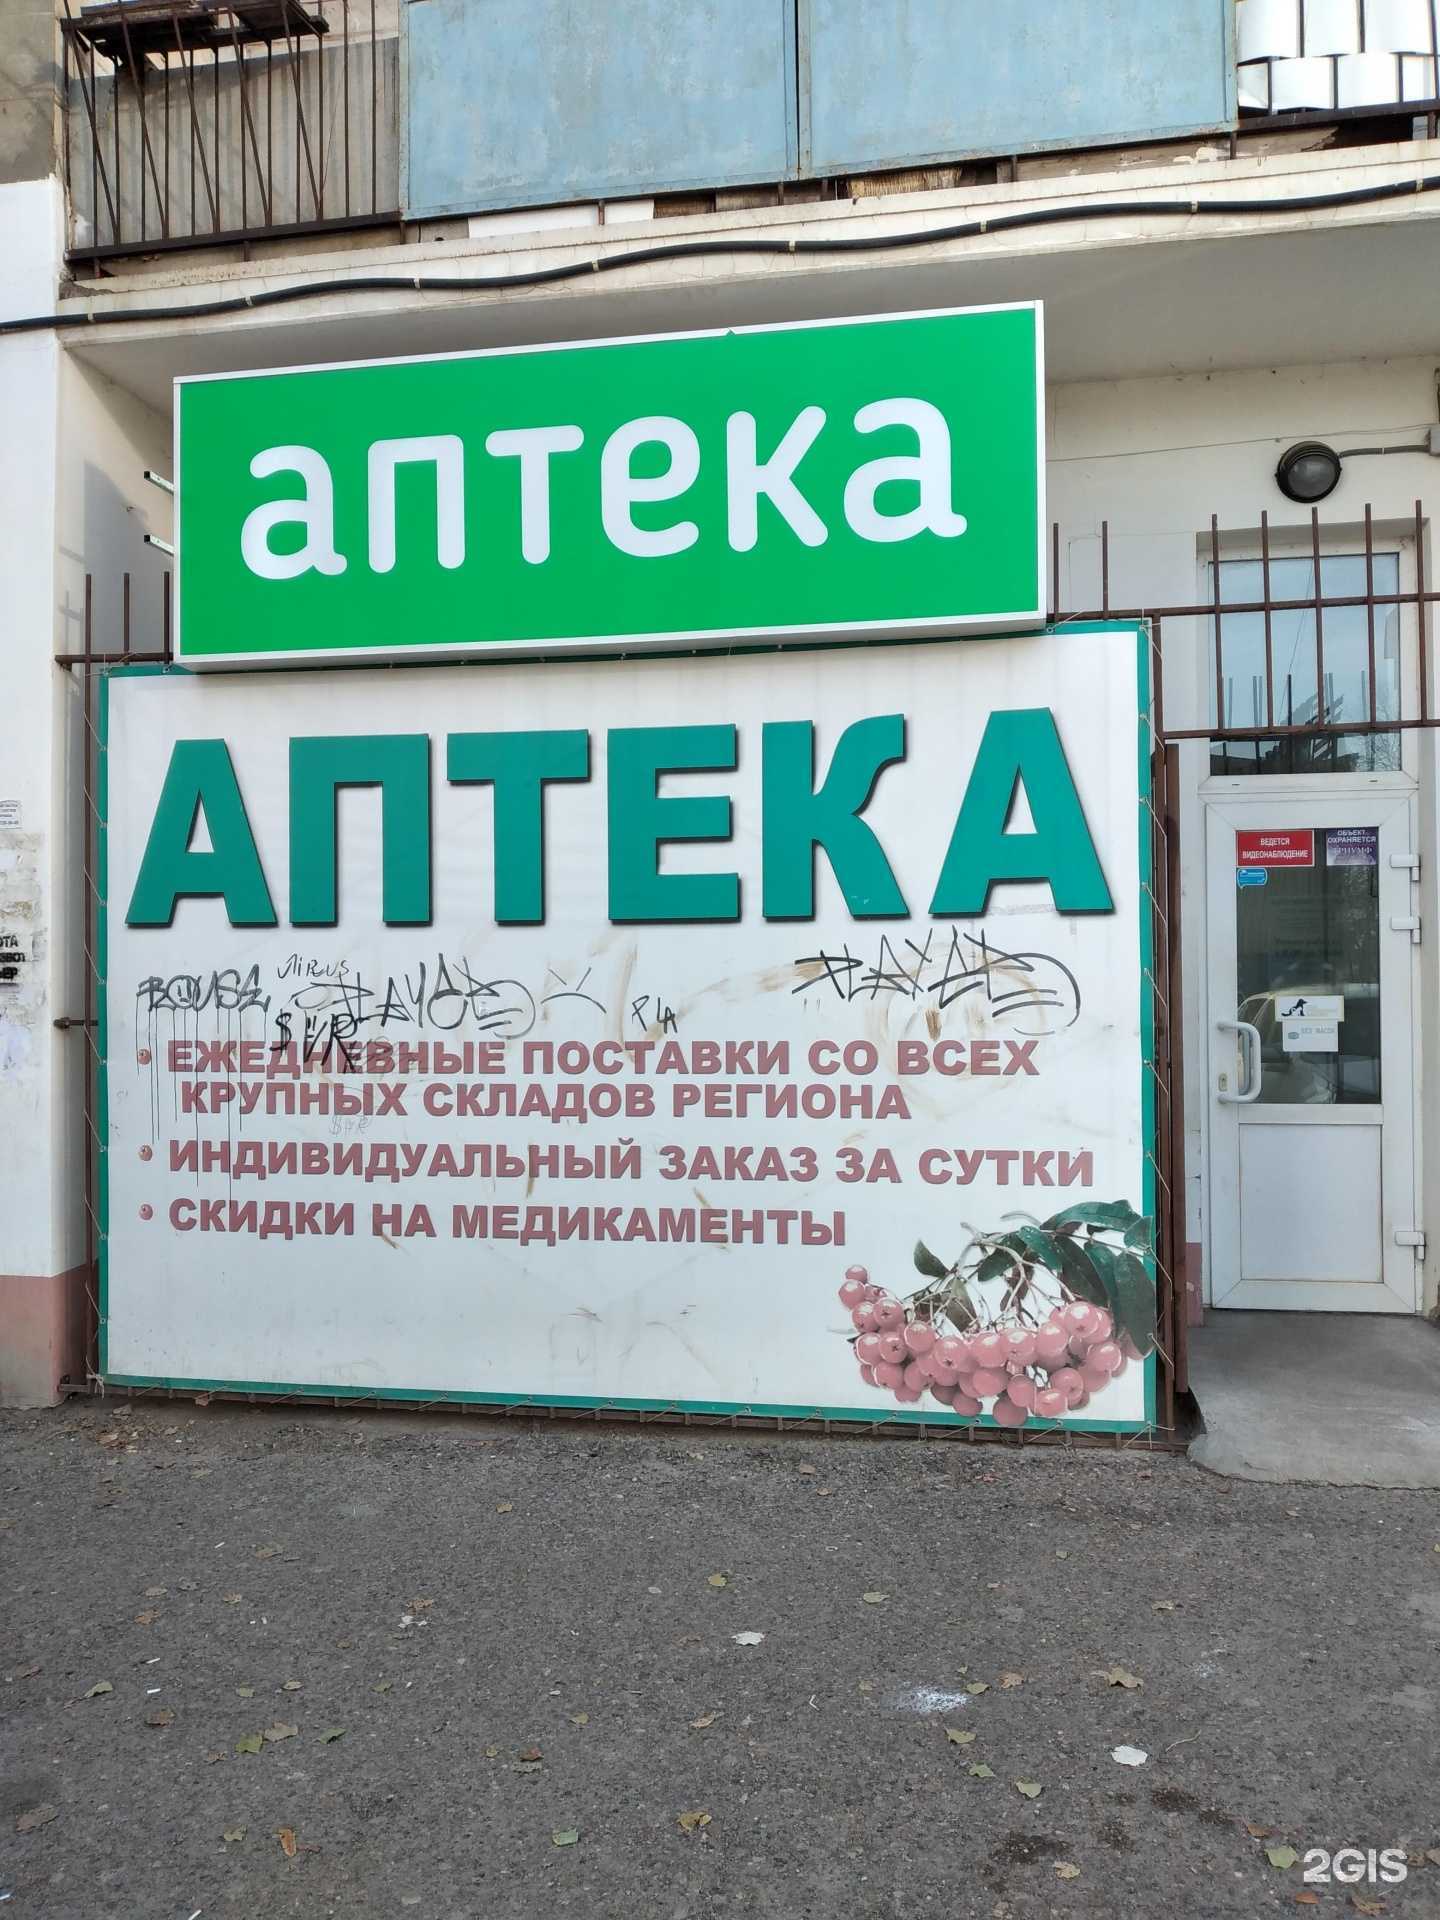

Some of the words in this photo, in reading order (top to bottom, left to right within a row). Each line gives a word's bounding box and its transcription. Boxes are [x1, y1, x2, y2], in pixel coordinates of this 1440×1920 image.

[241, 397, 967, 580] аптека
[125, 707, 1117, 927] АПТЕКА
[1242, 849, 1309, 861] ВИДЕОНАБЛЮДЕНИЕ
[1260, 837, 1290, 847] ВЕДЕТСЯ
[1327, 836, 1377, 844] ОХРАНЯЕТСЯ
[168, 1039, 505, 1080] ЕЖЕДНЕВНЫЕ
[523, 1039, 790, 1075] ПОСТАВКИ
[807, 1039, 879, 1076] СО
[897, 1040, 1041, 1076] ВСЕХ
[181, 1080, 408, 1116] КРУПНЫХ
[423, 1082, 655, 1123] СКЛАДОВ
[673, 1083, 912, 1120] РЕГИОНА
[169, 1137, 642, 1183] ИНДИВИДУАЛЬНЫЙ
[659, 1145, 820, 1183] ЗАКАЗ
[836, 1146, 902, 1184] ЗА
[918, 1149, 1094, 1187] СУТКИ
[169, 1198, 354, 1240] СКИДКИ
[372, 1203, 438, 1239] НА
[453, 1204, 847, 1247] МЕДИКАМЕНТЫ
